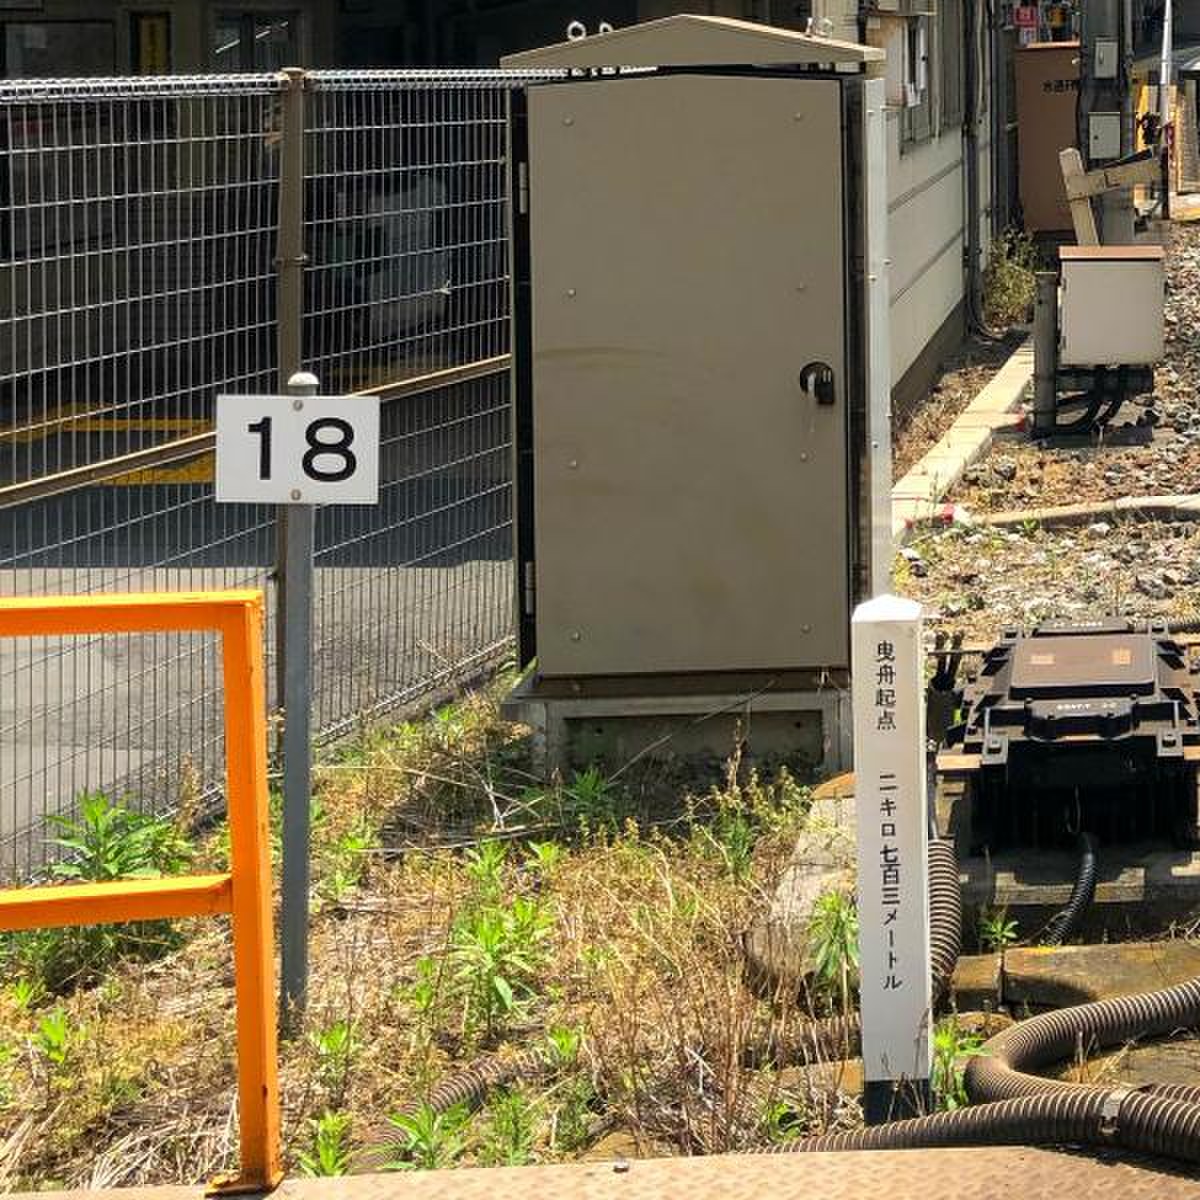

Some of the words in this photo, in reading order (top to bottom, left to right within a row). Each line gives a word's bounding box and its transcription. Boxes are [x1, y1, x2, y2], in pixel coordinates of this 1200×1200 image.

[248, 416, 357, 483] 18
[874, 639, 897, 732] 曳舟起点
[879, 773, 903, 991] 二キロ七百三メートル
